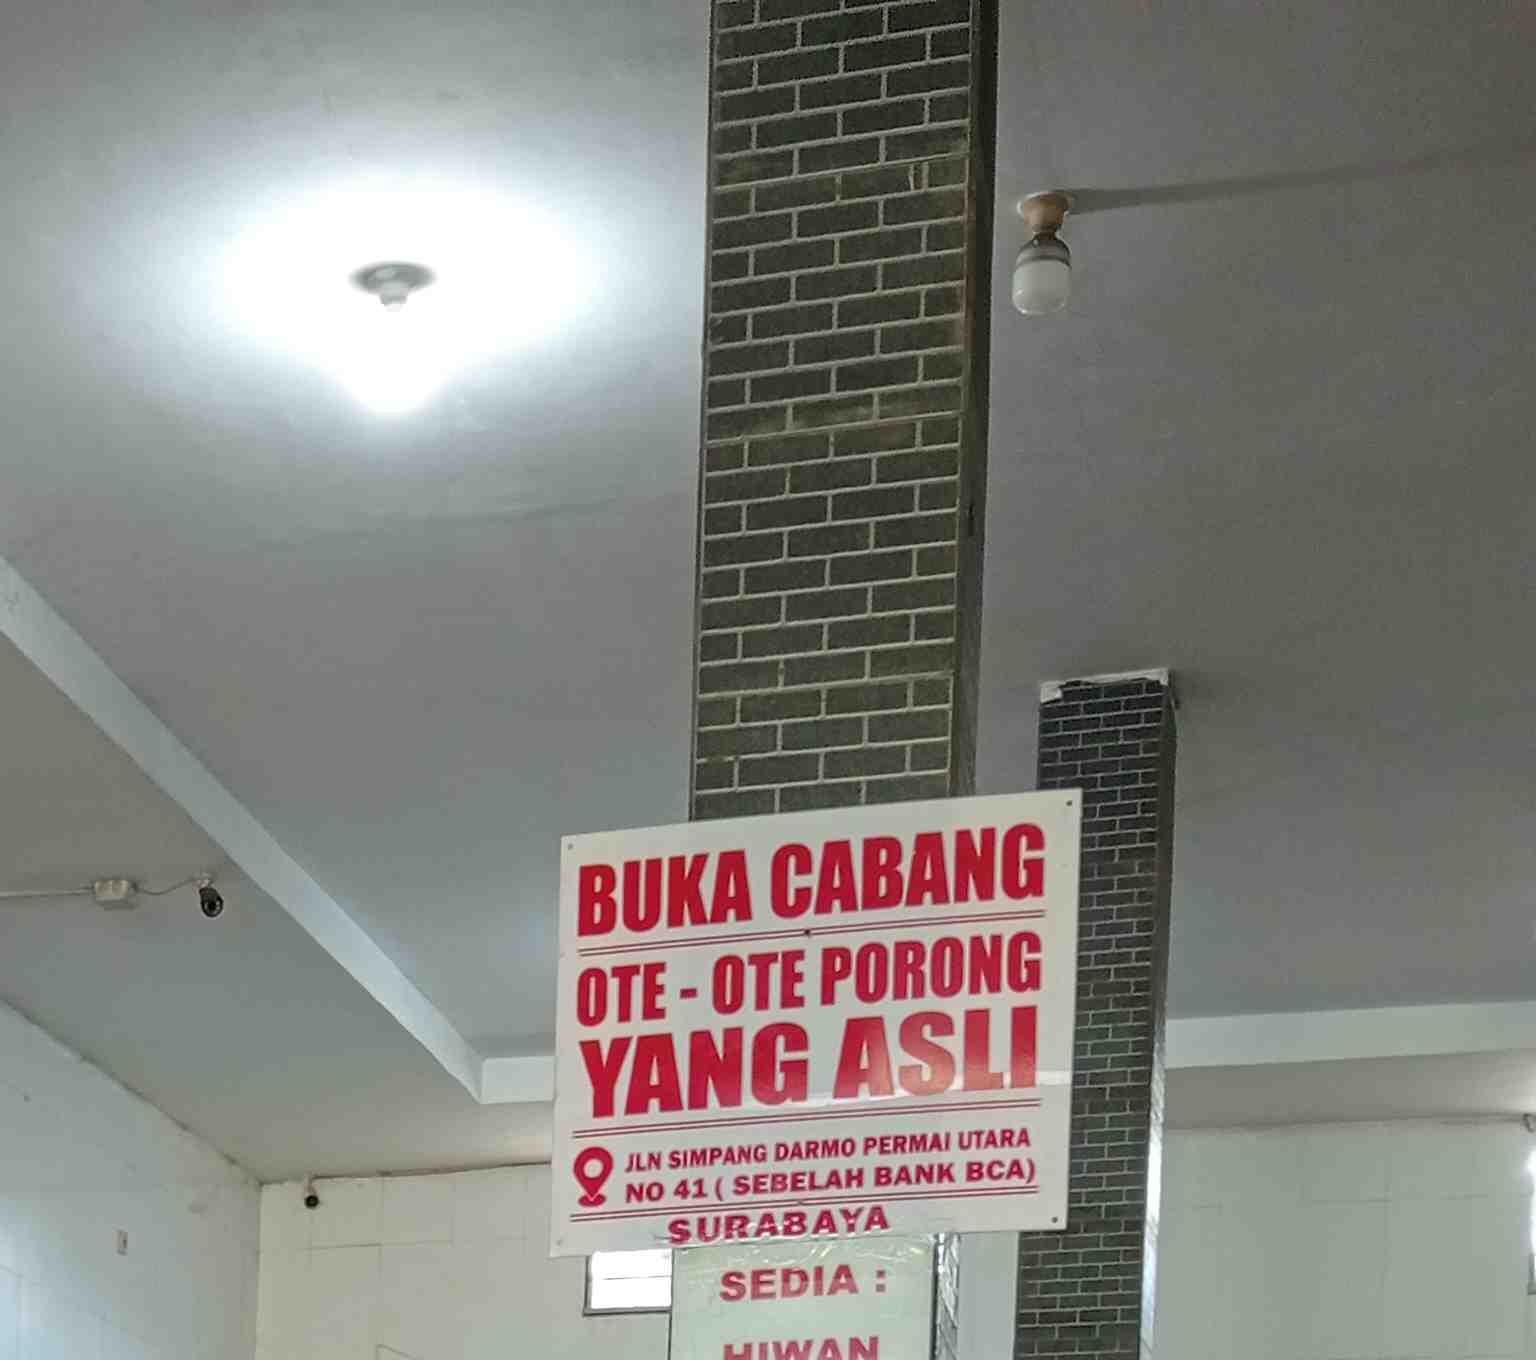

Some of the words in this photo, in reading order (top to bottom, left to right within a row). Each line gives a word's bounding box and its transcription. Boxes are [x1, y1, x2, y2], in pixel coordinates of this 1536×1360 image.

[576, 849, 752, 939] BUKA
[770, 822, 1047, 920] CABANG
[575, 960, 668, 1030] OTE
[711, 948, 807, 1016] OTE
[820, 929, 1042, 1008] PORONG
[578, 1021, 810, 1120] YANG
[833, 1002, 1039, 1100] ASLI
[624, 1152, 663, 1173] JLN
[666, 1145, 768, 1169] SIMPANG
[773, 1136, 857, 1162] DARMO
[862, 1134, 952, 1157] PERMAI
[957, 1127, 1030, 1152] UTARA
[625, 1179, 664, 1203] NO
[673, 1178, 706, 1201] 41
[735, 1168, 865, 1197] SEBELAH
[874, 1162, 955, 1191] BANK
[963, 1158, 1036, 1185] BCA)
[667, 1205, 889, 1245] SURABAYA
[720, 1264, 857, 1301] SEDIA
